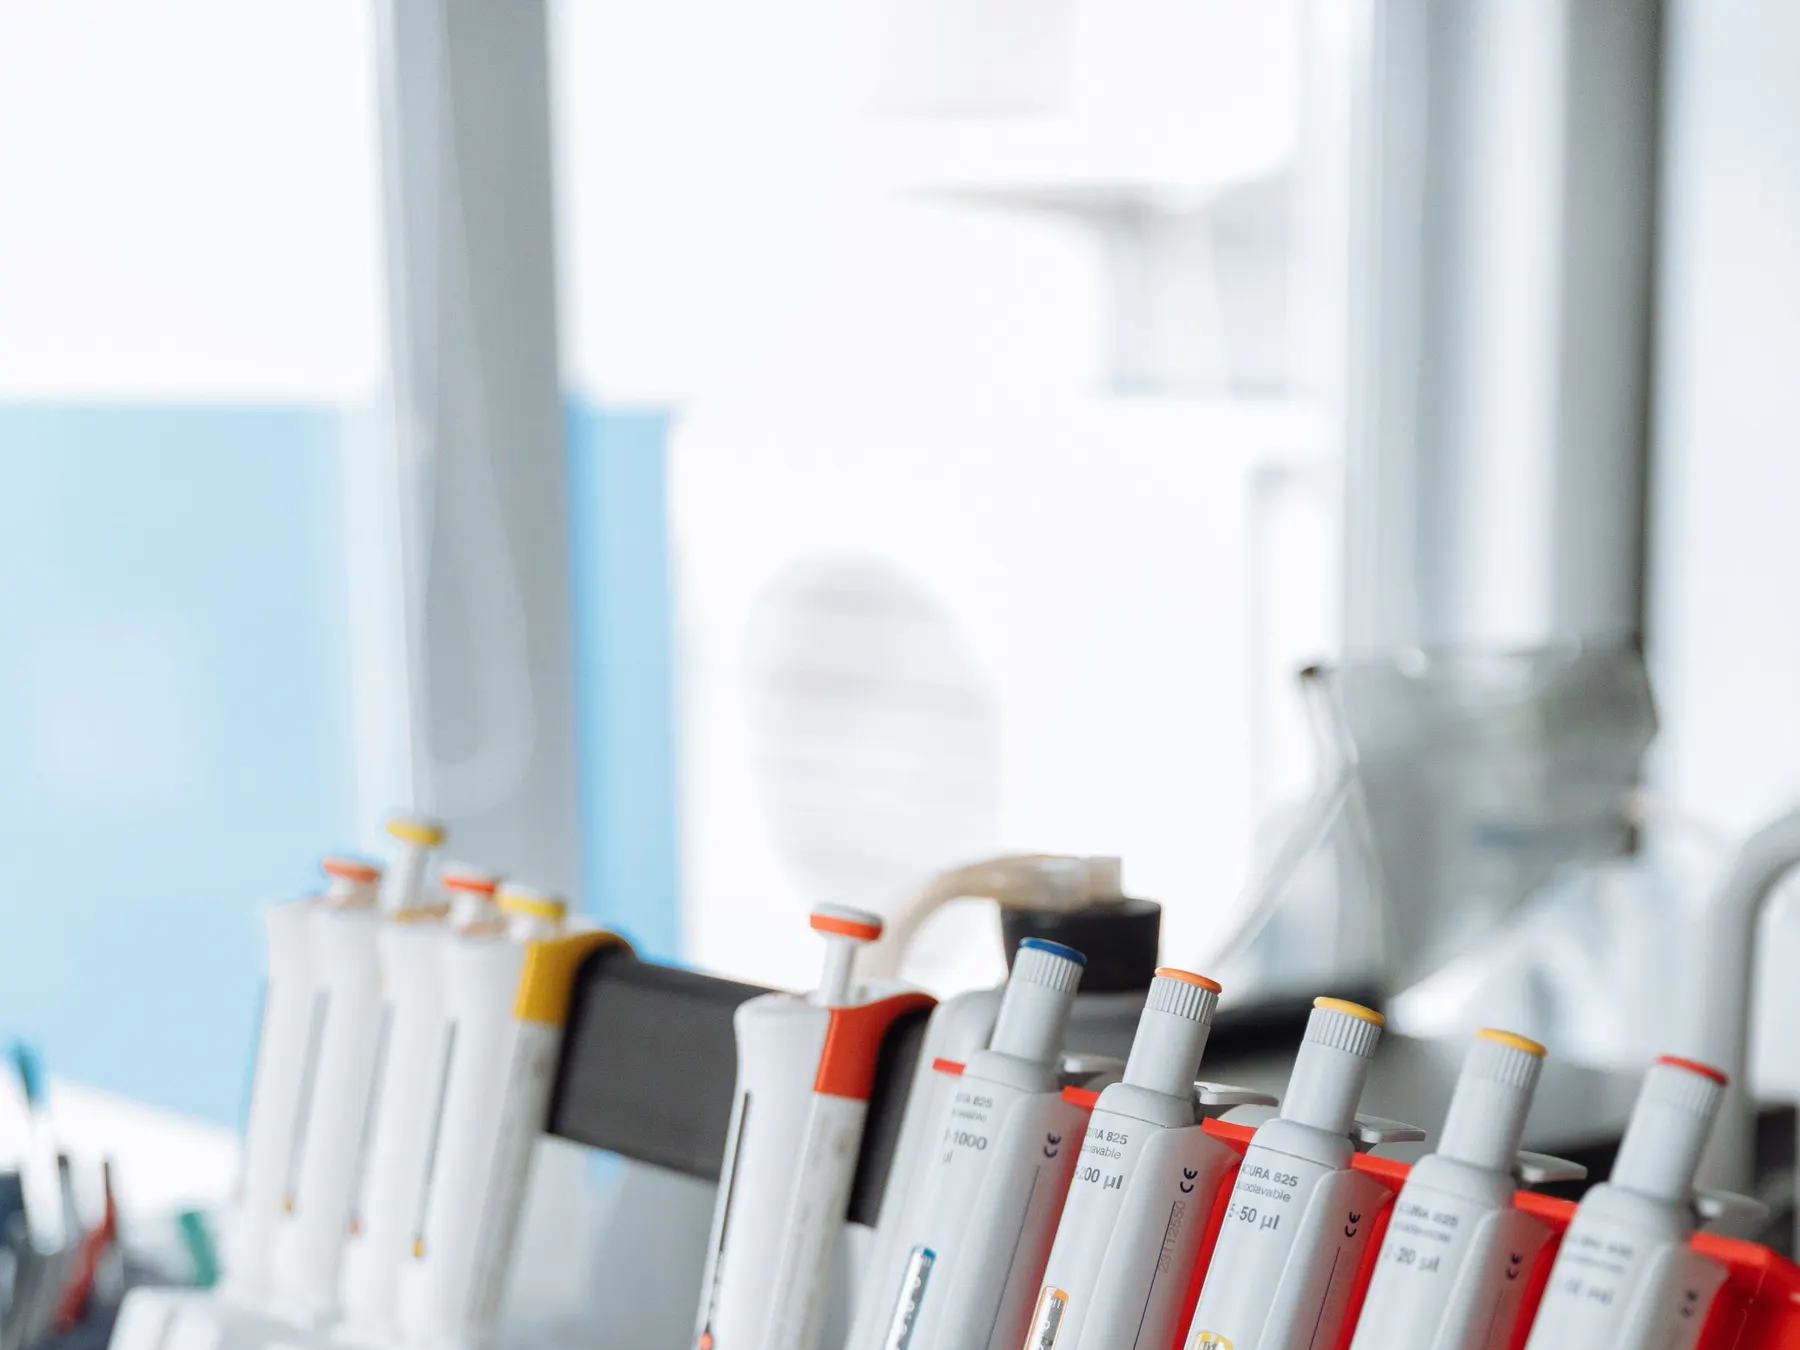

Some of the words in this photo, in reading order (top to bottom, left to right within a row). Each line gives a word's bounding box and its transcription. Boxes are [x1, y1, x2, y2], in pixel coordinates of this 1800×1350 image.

[973, 1096, 994, 1109] 825
[1106, 1131, 1129, 1145] 825
[1103, 1174, 1124, 1190] µl
[1273, 1172, 1299, 1187] 825
[1259, 1213, 1281, 1231] µl
